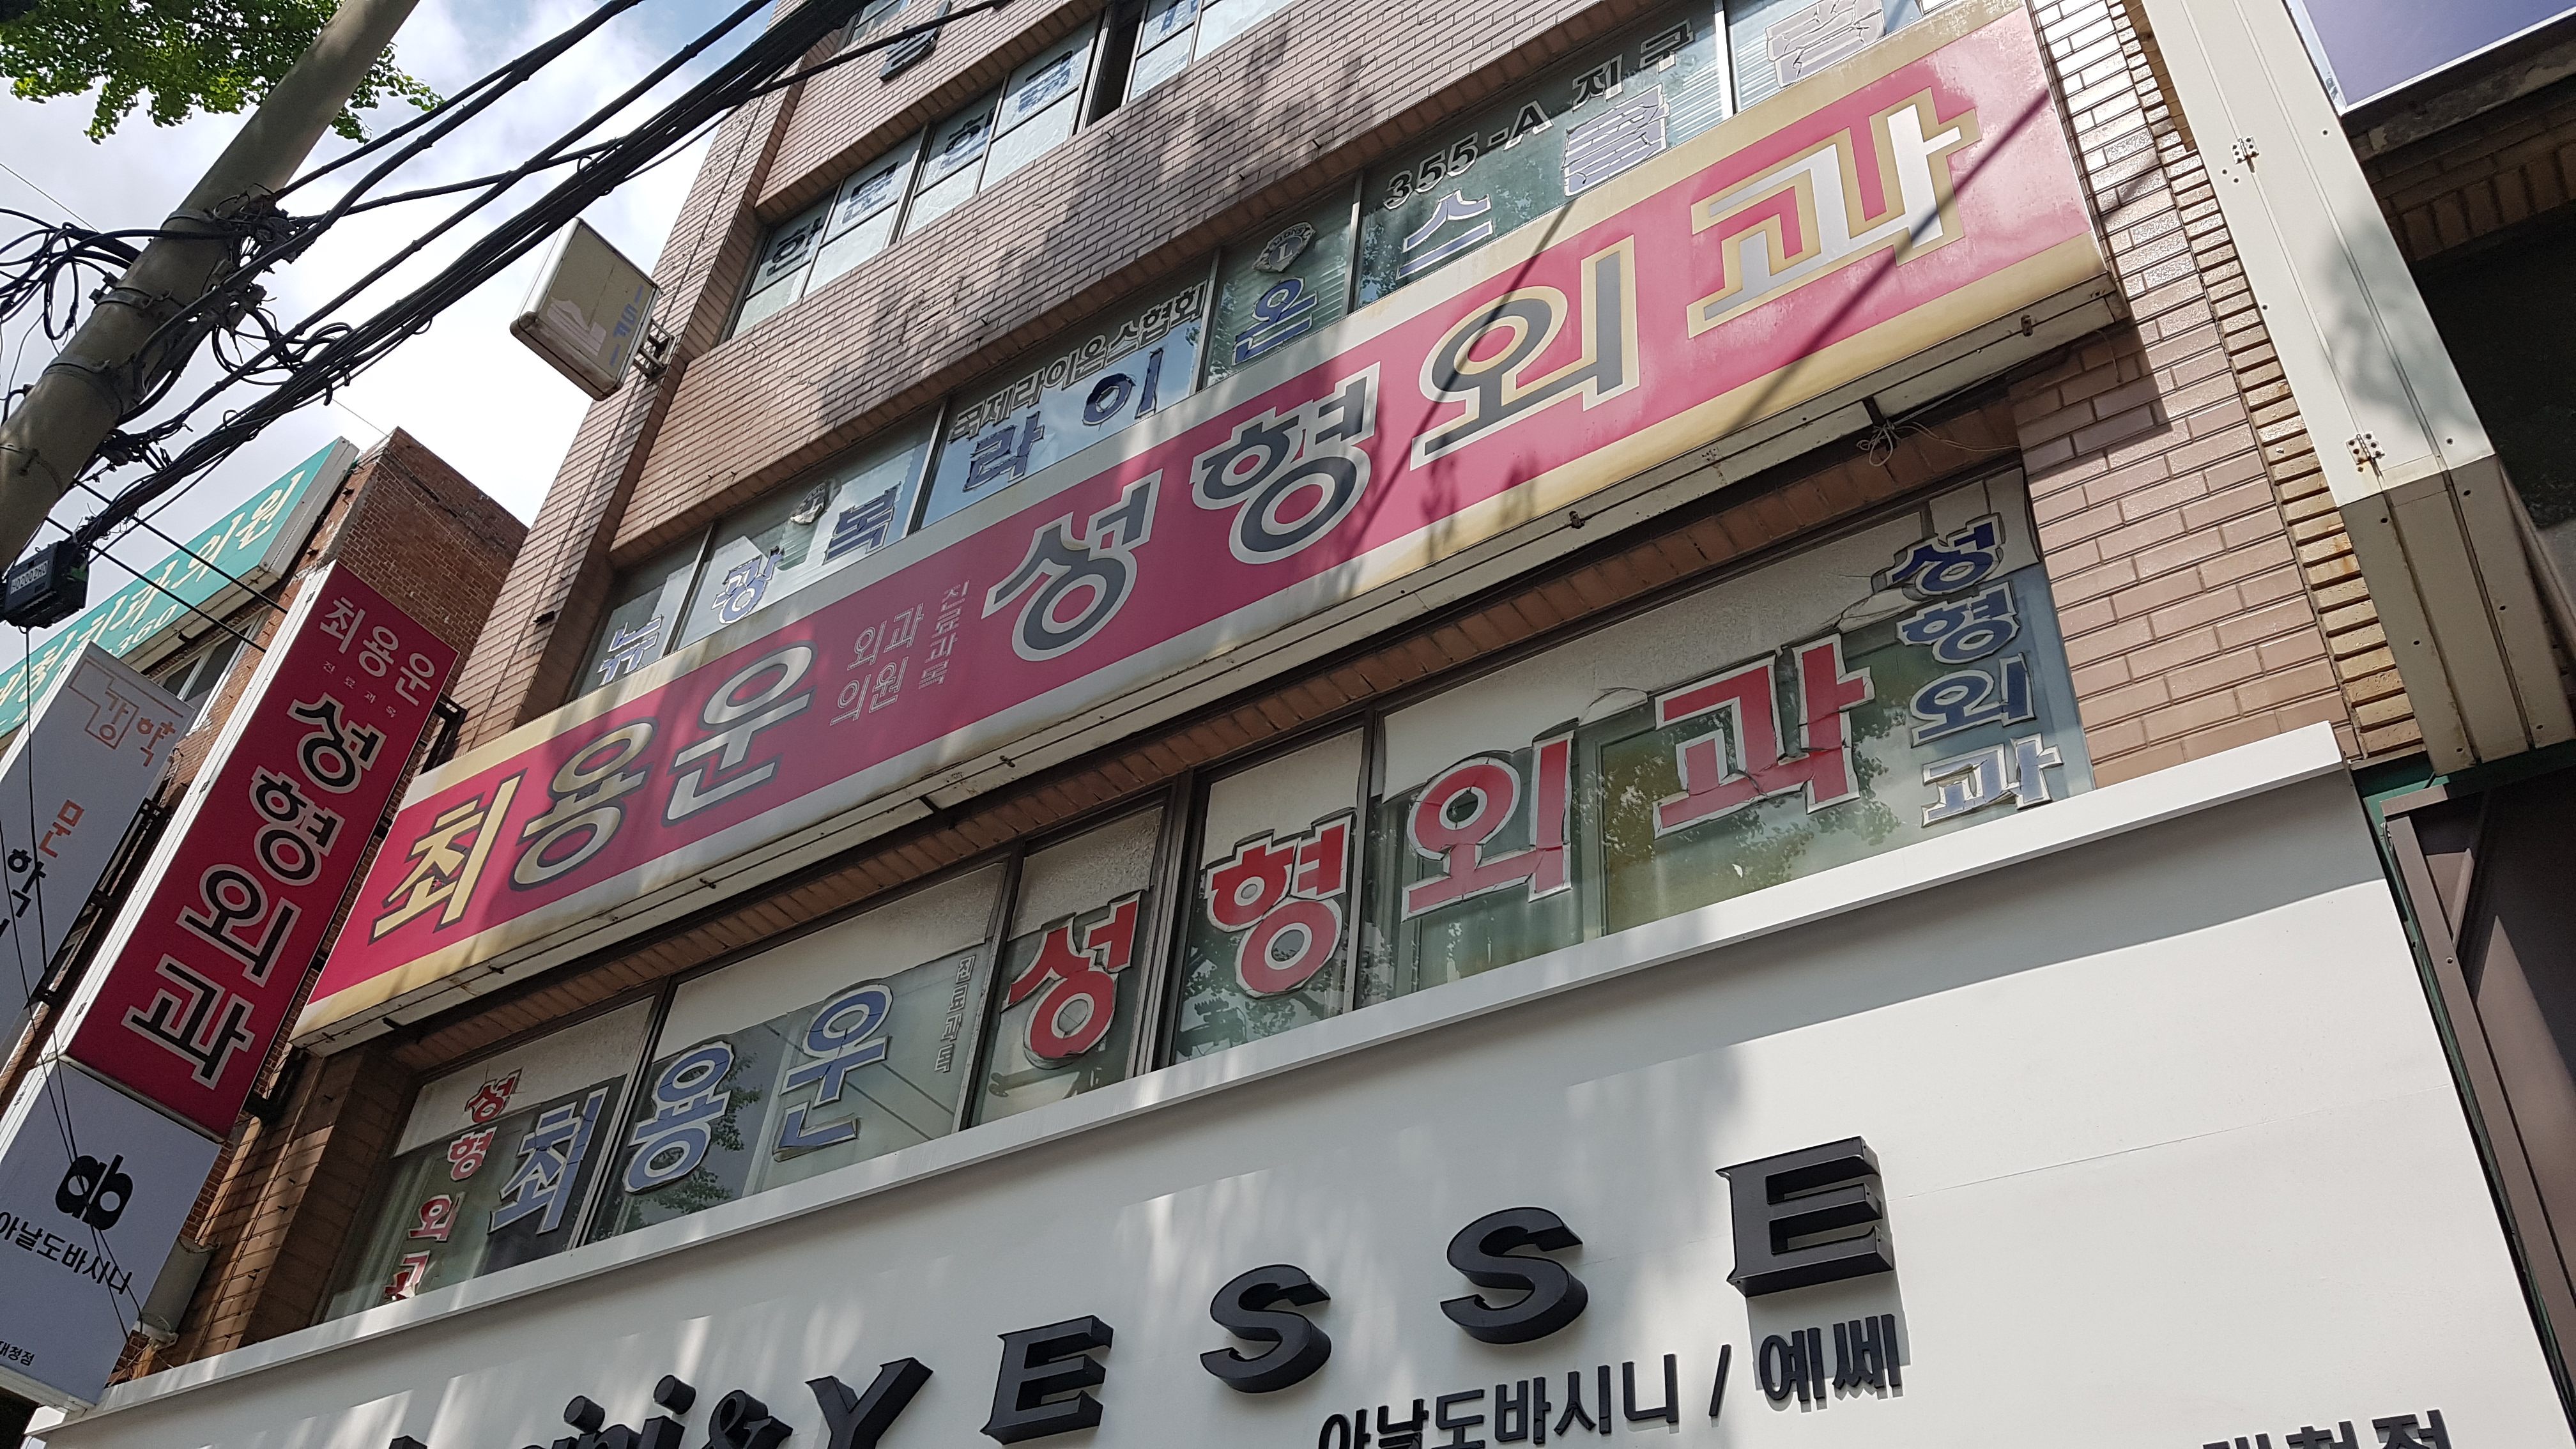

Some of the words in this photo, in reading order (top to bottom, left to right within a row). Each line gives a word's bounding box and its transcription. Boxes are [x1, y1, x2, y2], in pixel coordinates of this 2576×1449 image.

[949, 279, 1208, 443] 국제라이온스협회
[1383, 100, 1554, 210] 355-A
[981, 88, 1981, 663] 성형외과
[320, 596, 435, 707] 최용운
[829, 656, 908, 726] 의원
[847, 602, 924, 671] 외과
[918, 579, 969, 689] 진료과목
[1872, 513, 2064, 827] 성형외과
[121, 692, 388, 1091] 성형외과
[368, 639, 817, 946] 최용운
[1001, 632, 1875, 1067] 성형외과
[487, 981, 893, 1235] 최용운
